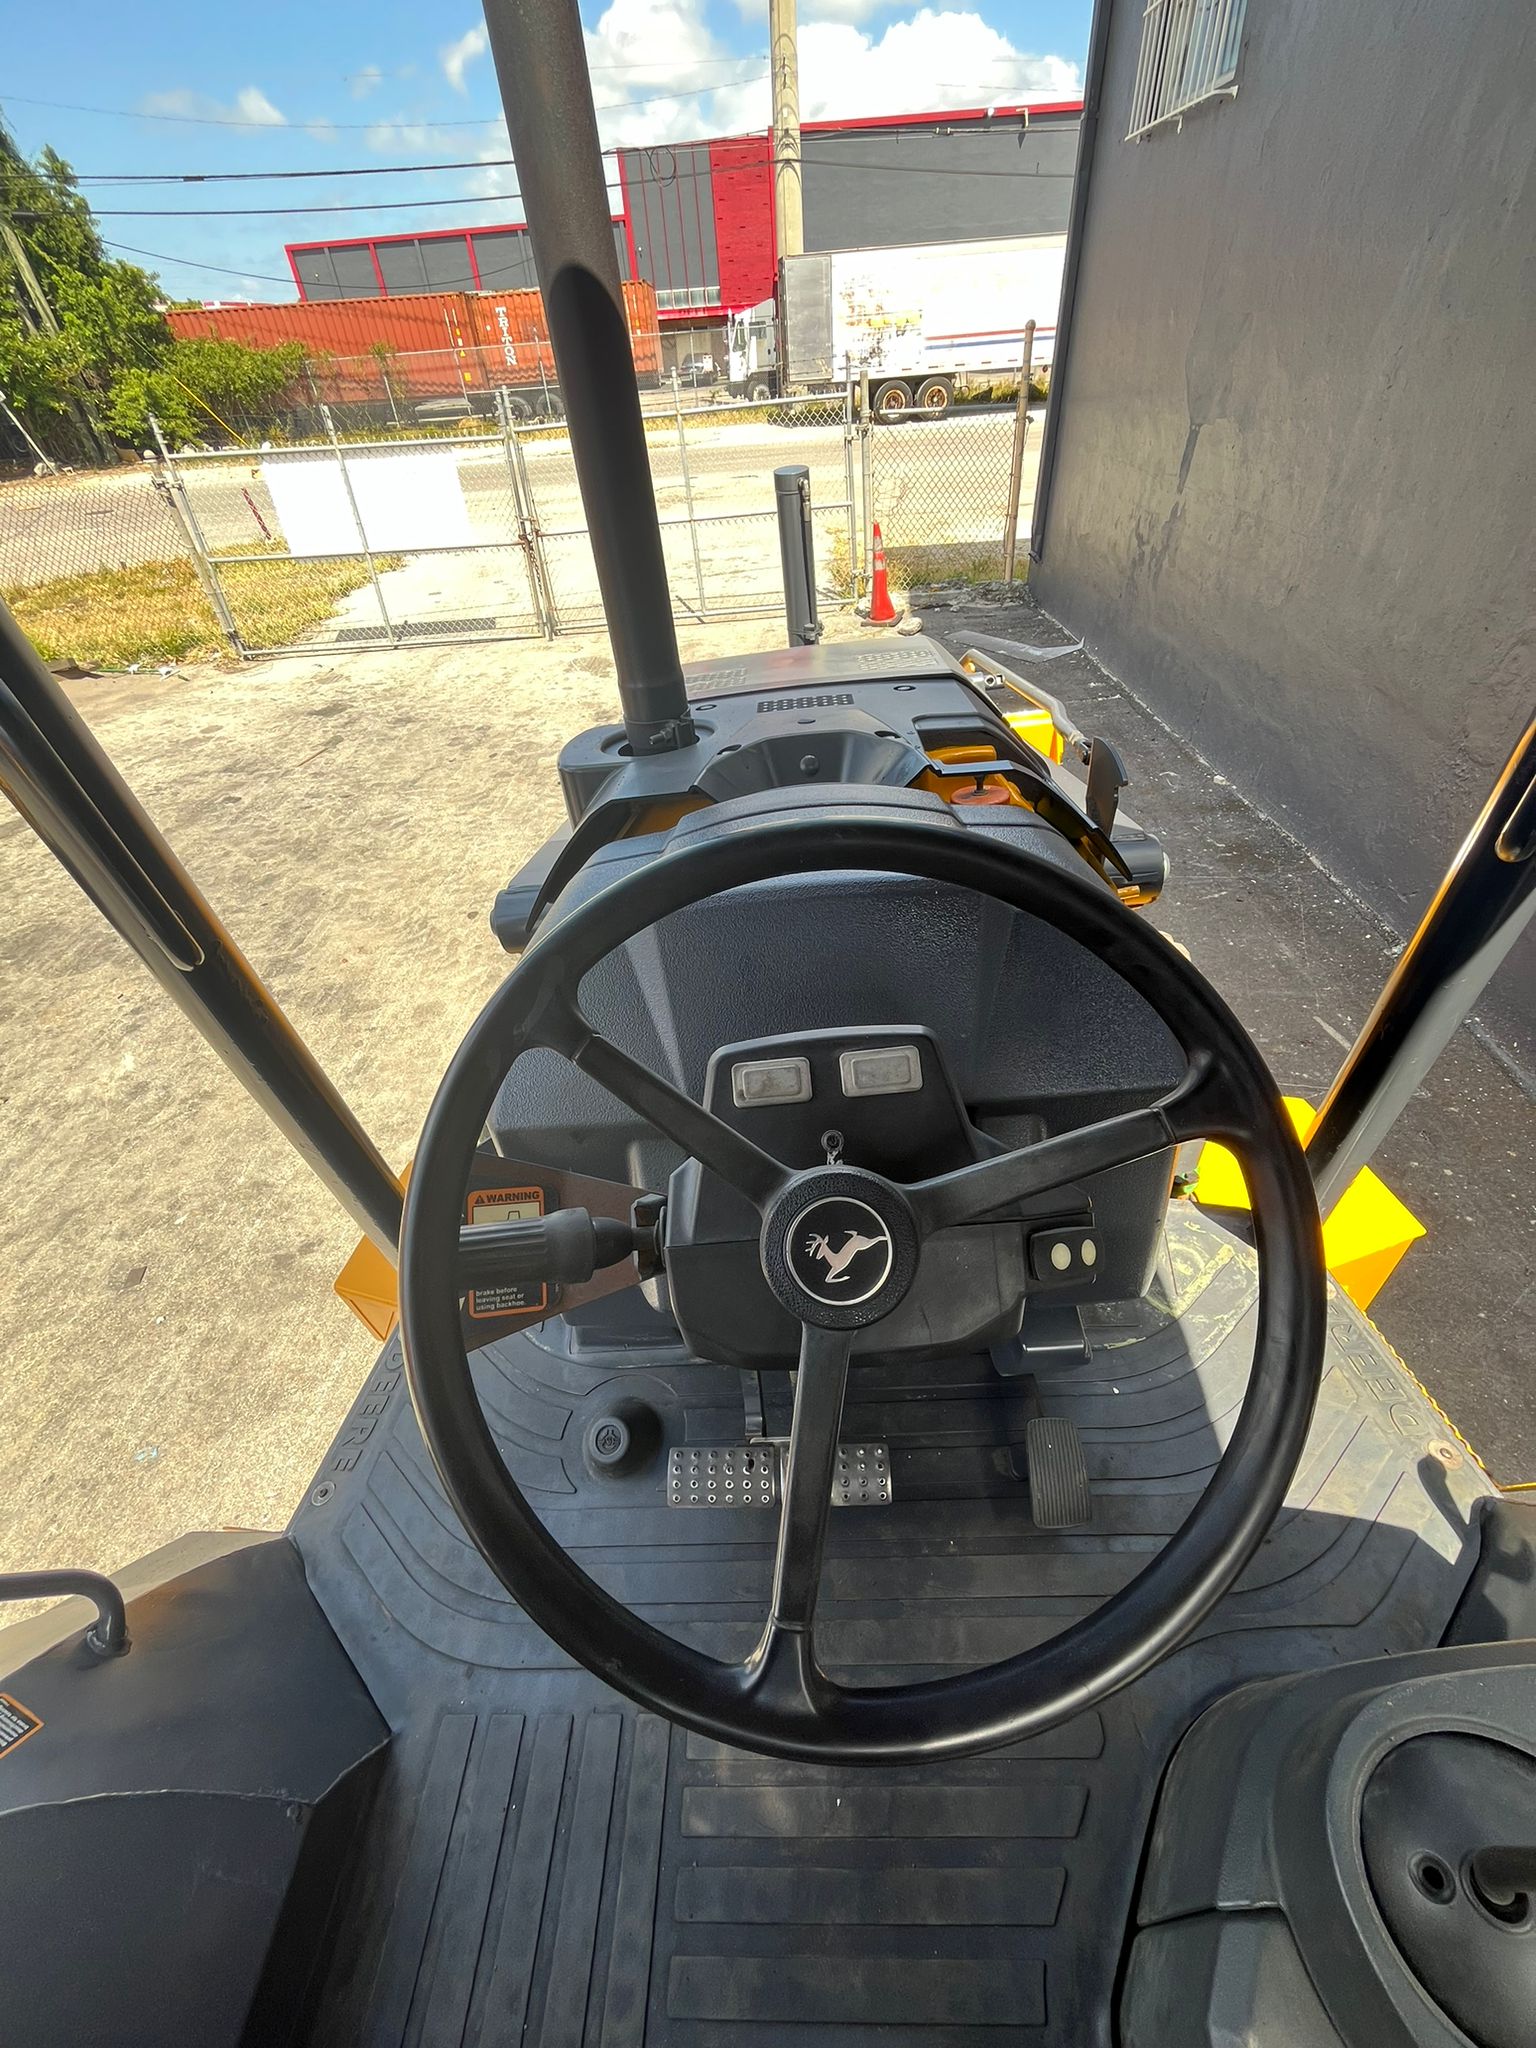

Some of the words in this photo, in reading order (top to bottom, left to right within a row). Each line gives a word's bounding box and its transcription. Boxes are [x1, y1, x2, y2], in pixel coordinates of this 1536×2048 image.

[495, 306, 517, 366] TRITON
[486, 1191, 540, 1204] WARNING
[476, 1288, 495, 1297] brake
[496, 1287, 518, 1295] before
[476, 1294, 501, 1304] leaving
[502, 1293, 516, 1301] seat
[476, 1303, 495, 1311] using
